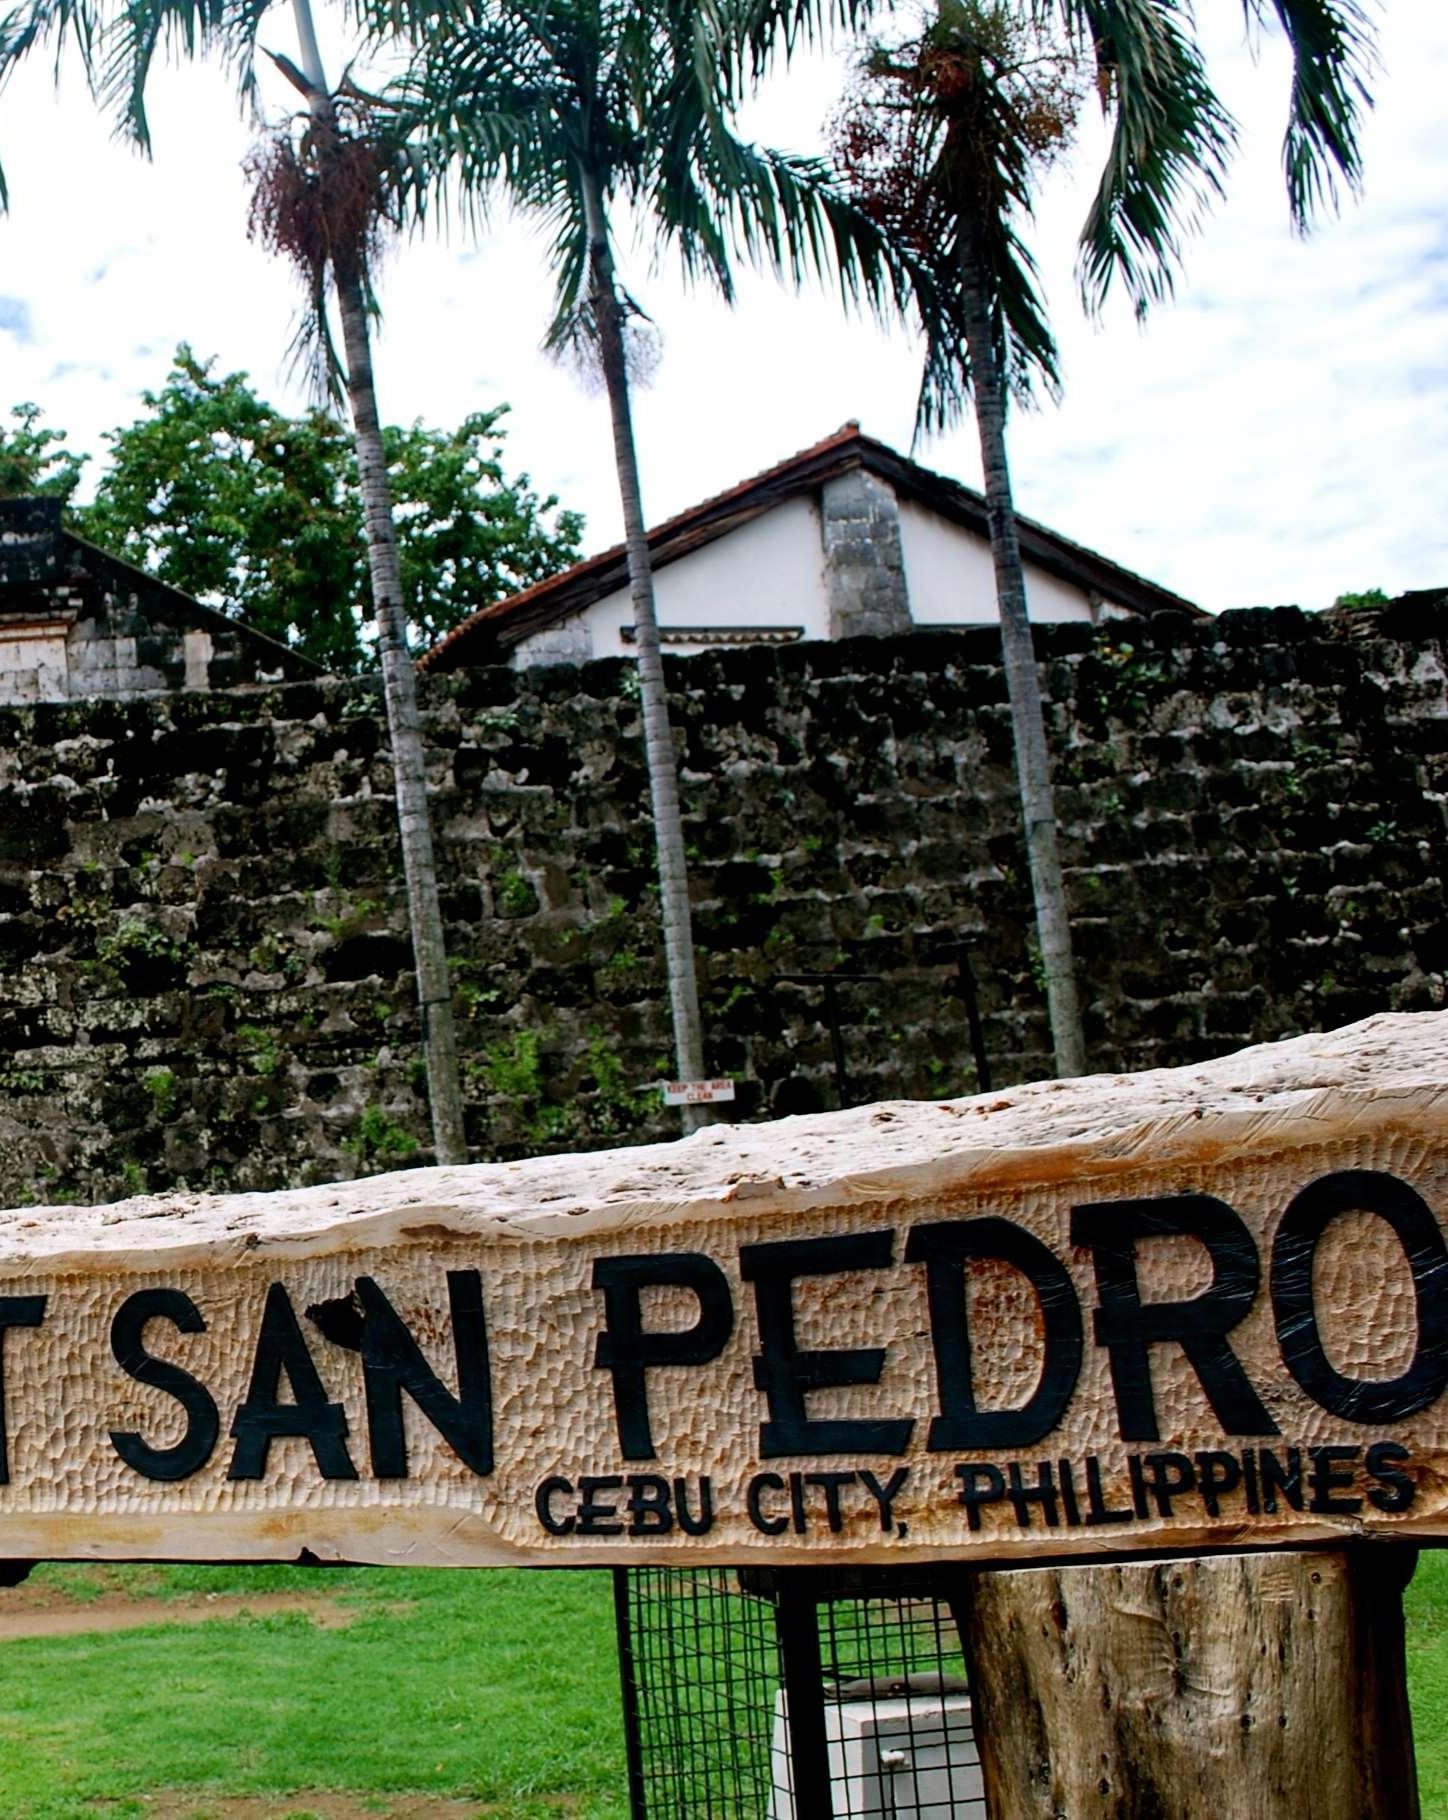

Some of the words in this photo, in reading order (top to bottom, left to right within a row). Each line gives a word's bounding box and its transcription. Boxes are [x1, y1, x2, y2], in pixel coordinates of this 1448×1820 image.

[667, 1083, 688, 1094] KEEP
[691, 1082, 707, 1091] THE
[711, 1080, 732, 1090] AREA
[109, 1268, 495, 1482] SAN
[591, 1168, 1448, 1461] PEDRO
[535, 1474, 713, 1538] CEBU
[748, 1466, 909, 1538] CITY,
[954, 1441, 1416, 1532] PHILIPPINES
